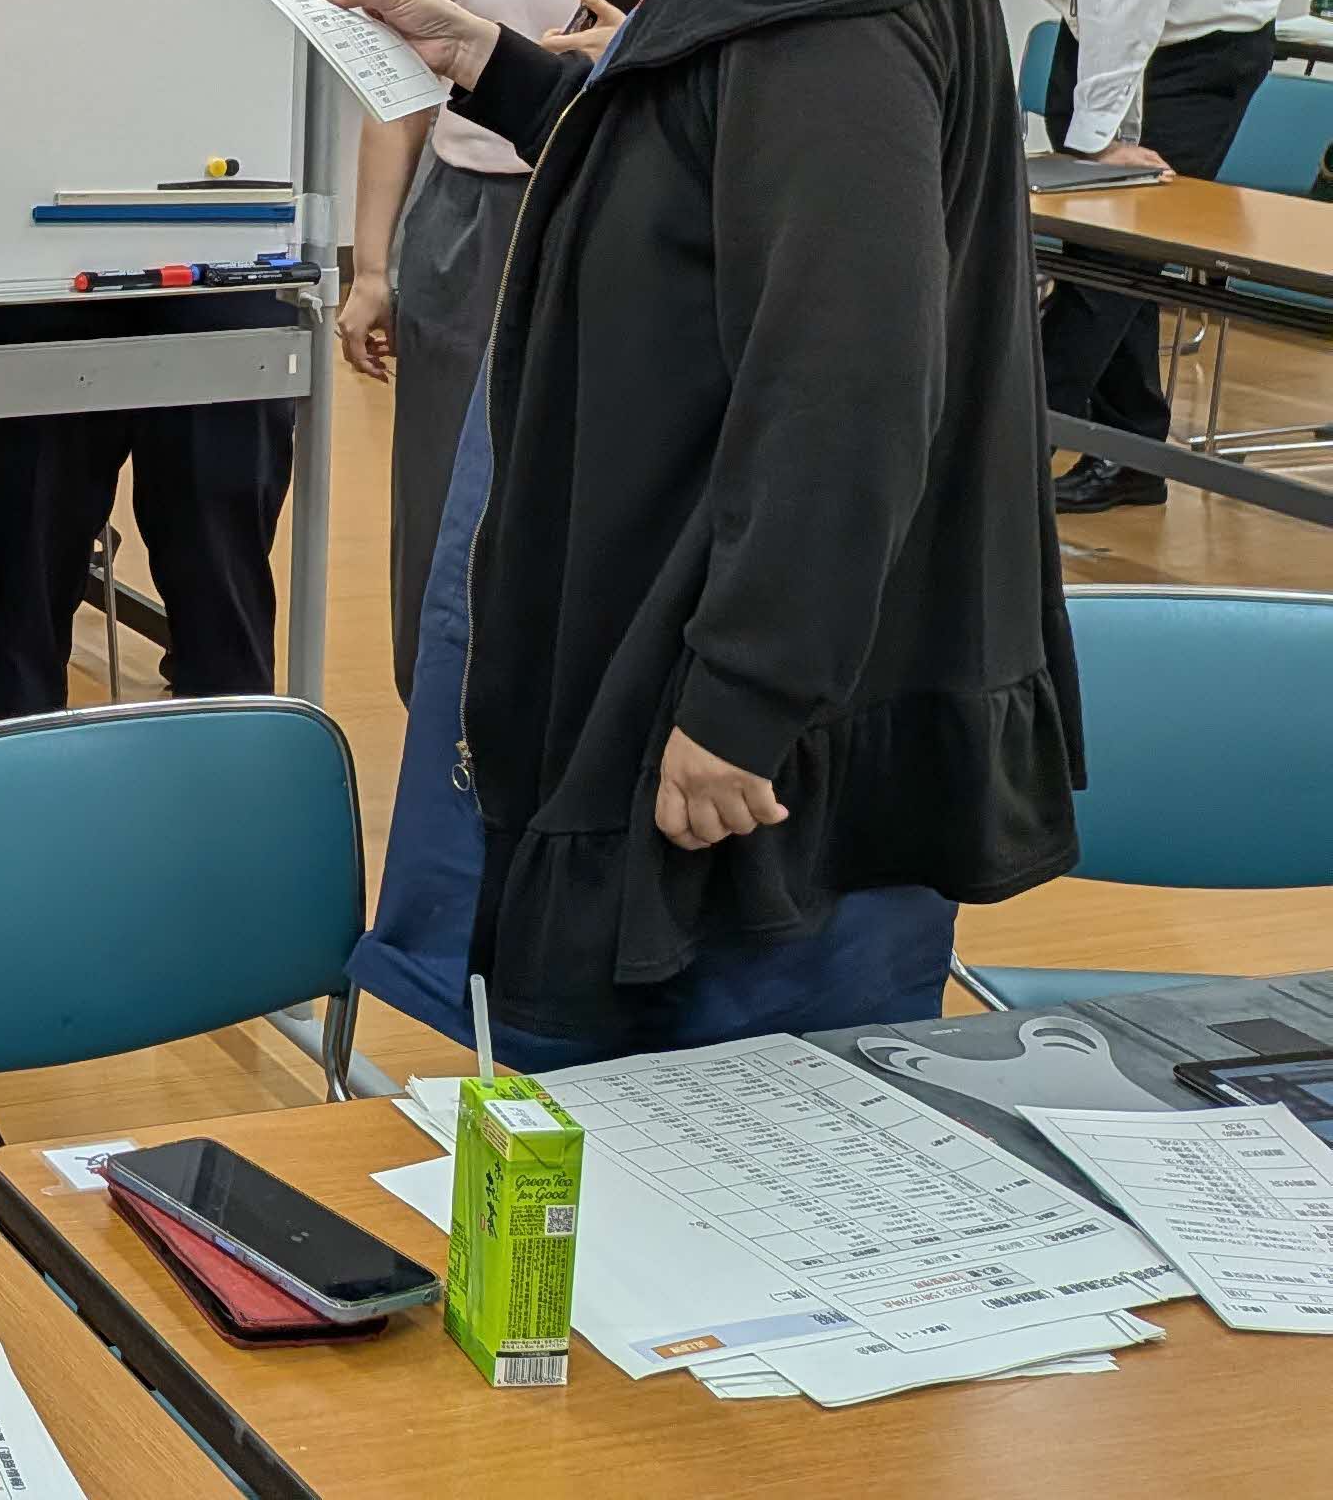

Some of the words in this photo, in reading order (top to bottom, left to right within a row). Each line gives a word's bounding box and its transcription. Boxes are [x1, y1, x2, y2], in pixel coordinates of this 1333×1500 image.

[515, 1175, 551, 1192] Green
[552, 1171, 573, 1188] Tea
[517, 1190, 534, 1202] for
[535, 1186, 569, 1204] Good
